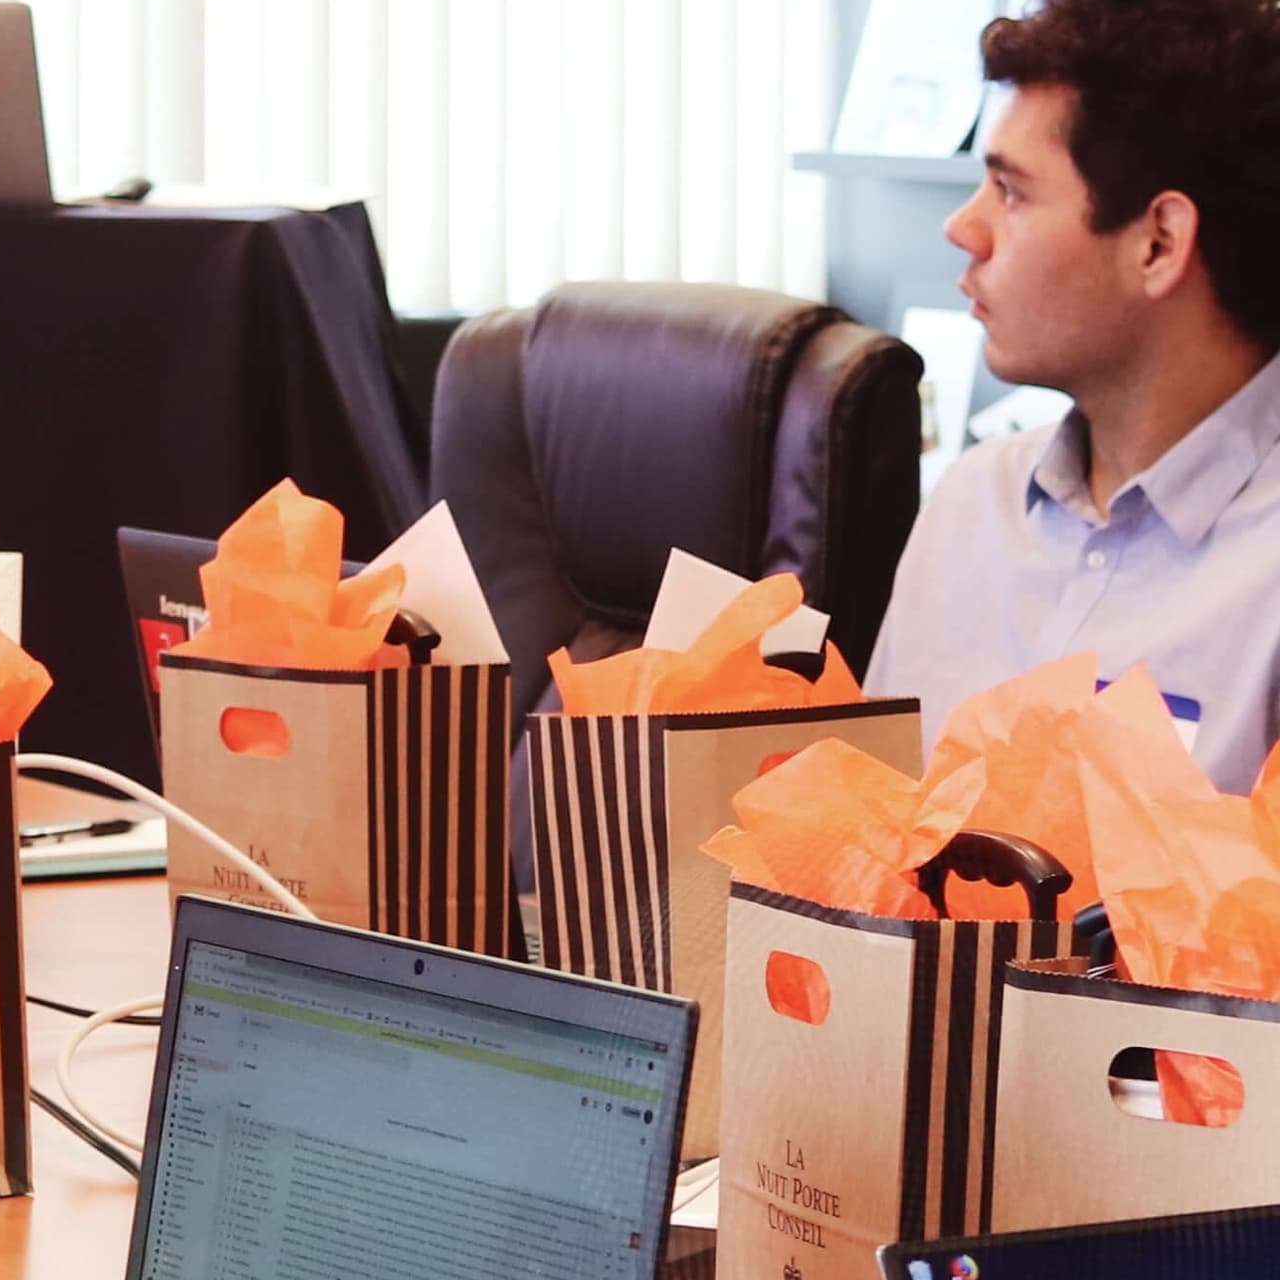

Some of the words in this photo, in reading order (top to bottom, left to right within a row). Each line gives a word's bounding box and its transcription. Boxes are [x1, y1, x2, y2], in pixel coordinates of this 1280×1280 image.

[786, 1139, 805, 1171] LA
[756, 1162, 788, 1198] NUIT
[792, 1177, 841, 1218] PORTE
[768, 1203, 826, 1249] CONSEIL
